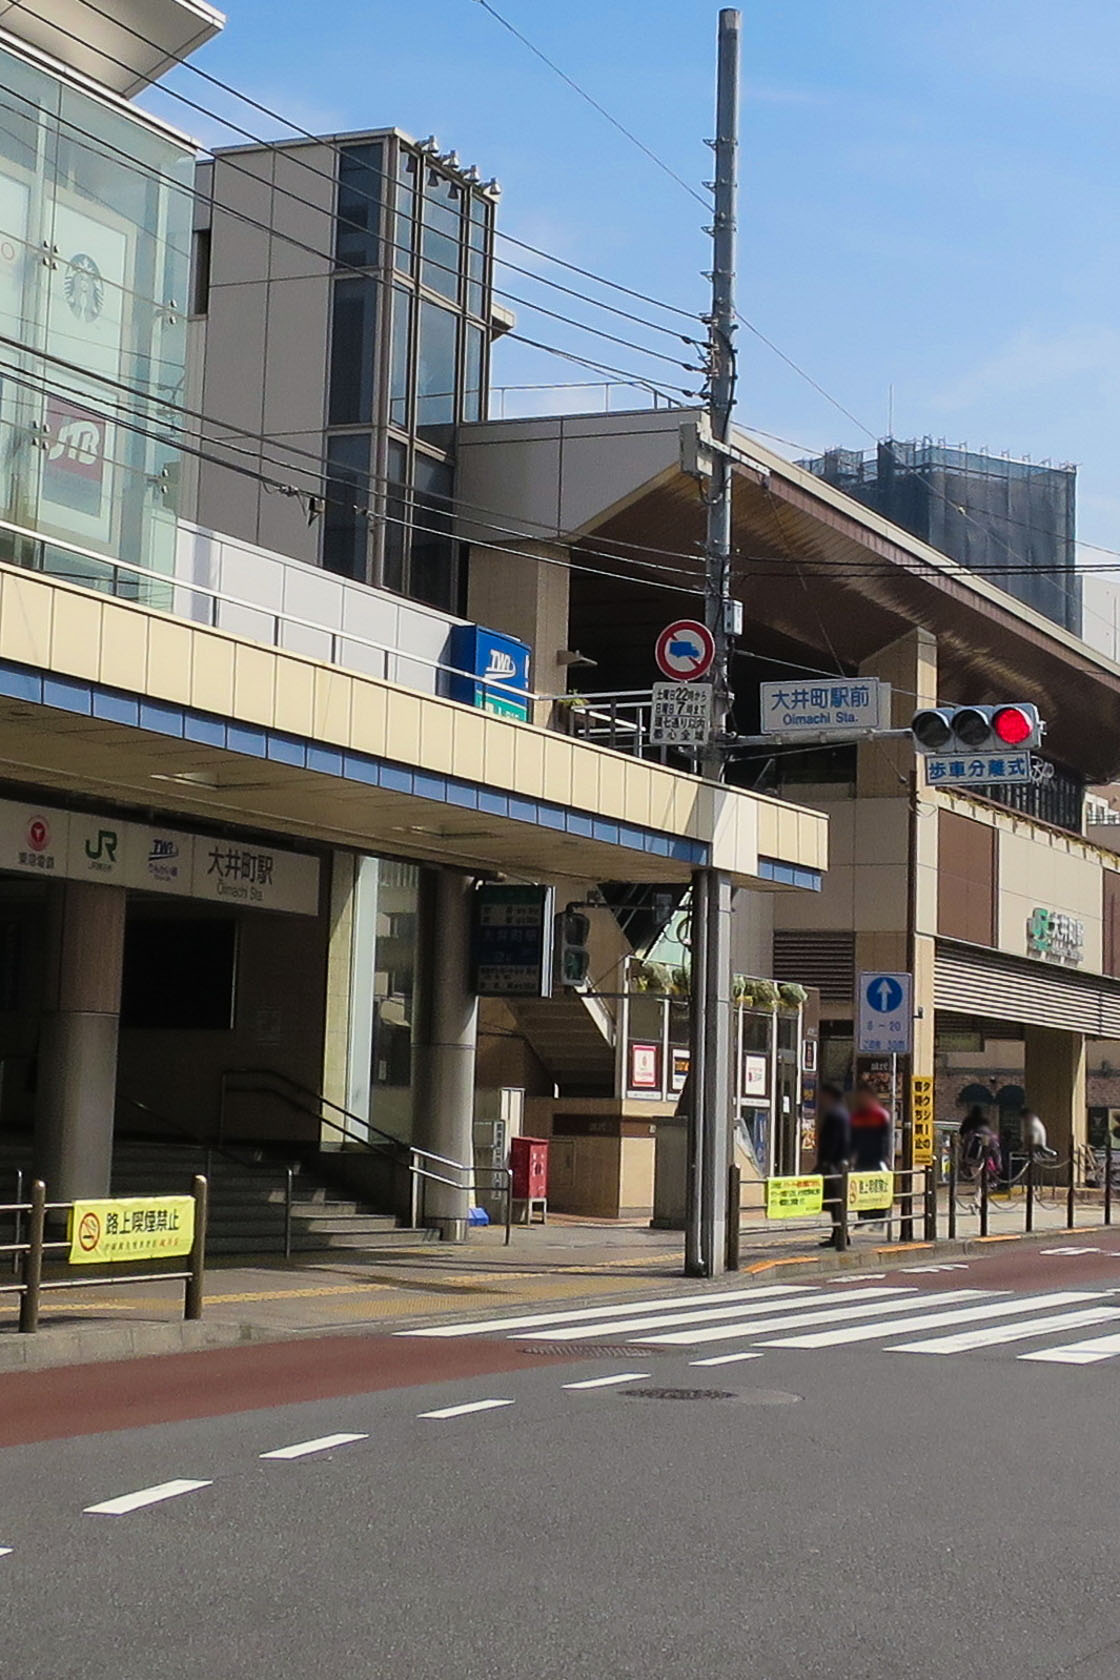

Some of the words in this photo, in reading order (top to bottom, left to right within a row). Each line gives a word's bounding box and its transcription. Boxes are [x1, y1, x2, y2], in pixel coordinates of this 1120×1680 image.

[771, 685, 870, 712] 大井町駅前
[782, 711, 831, 726] Oimachi
[928, 757, 1026, 780] 歩車分離式
[84, 829, 118, 863] JR
[207, 846, 274, 886] 大井町駅
[105, 1208, 180, 1236] 路上喫煙禁止
